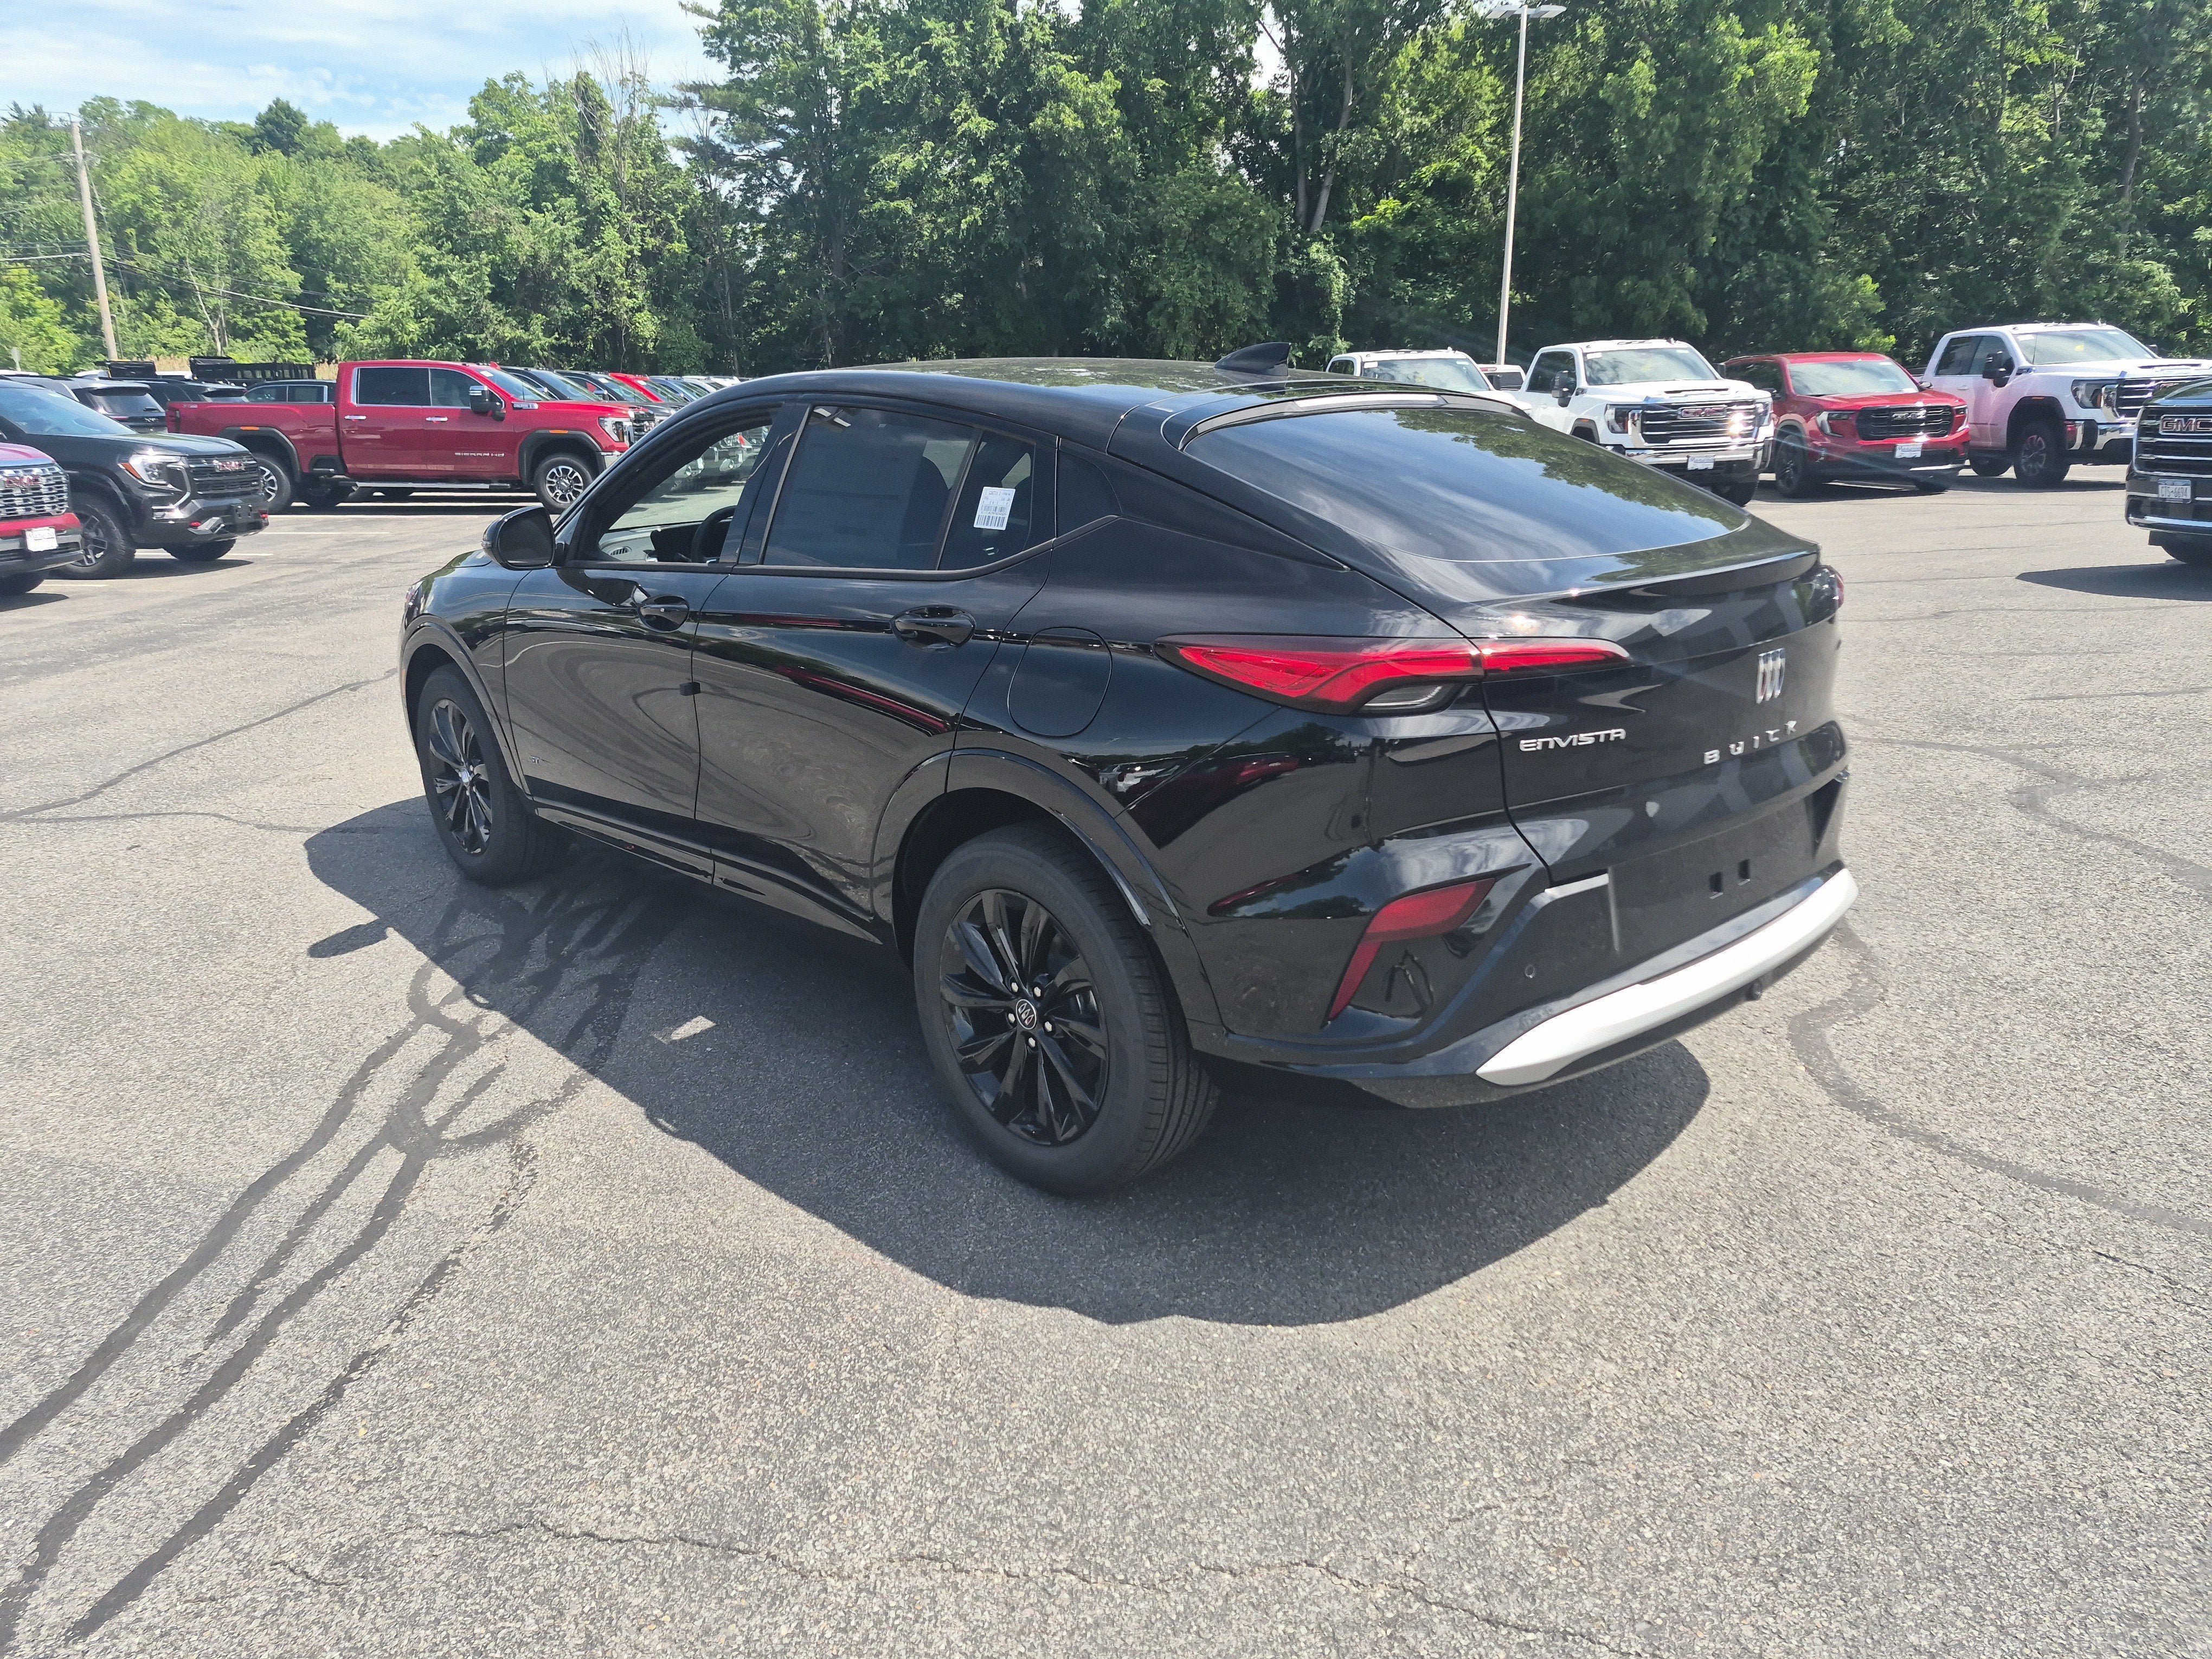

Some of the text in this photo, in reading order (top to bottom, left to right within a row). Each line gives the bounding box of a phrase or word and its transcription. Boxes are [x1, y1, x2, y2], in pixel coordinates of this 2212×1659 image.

[1682, 407, 1724, 417] GMC
[2162, 418, 2212, 432] GMC
[1519, 729, 1626, 751] ENVISTA
[1703, 721, 1797, 765] BUICK
